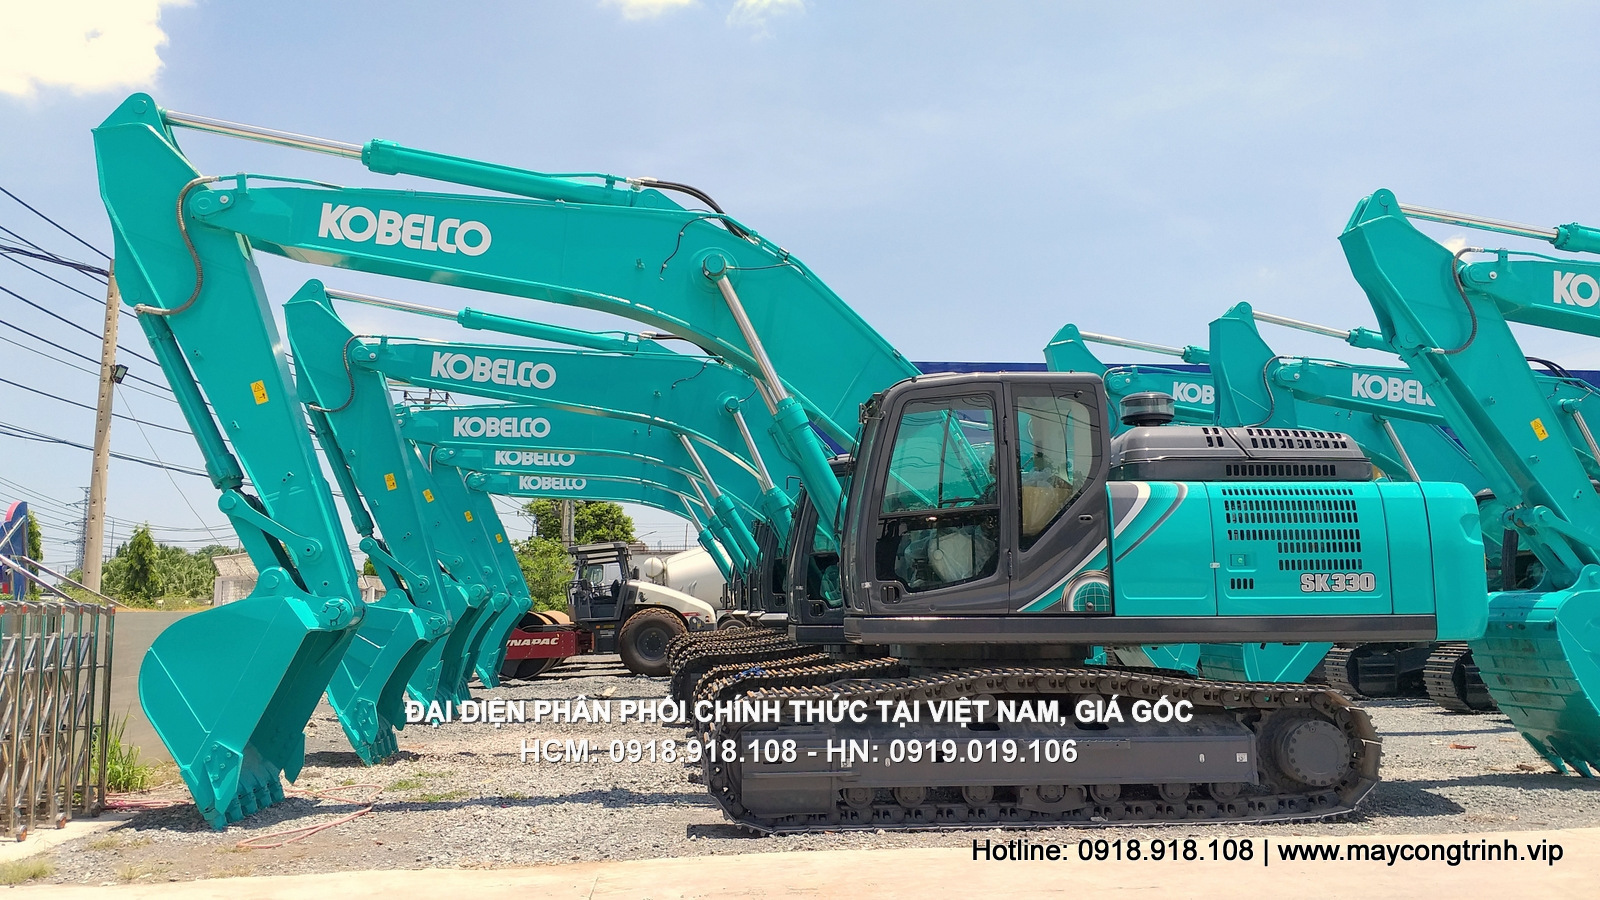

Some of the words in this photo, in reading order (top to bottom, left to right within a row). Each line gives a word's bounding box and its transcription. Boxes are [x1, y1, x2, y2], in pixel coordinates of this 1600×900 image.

[318, 202, 492, 256] KOBELCO
[1553, 270, 1600, 307] KO
[431, 351, 557, 389] KOBELCO
[453, 416, 551, 438] KOBELCO
[1300, 572, 1376, 593] SK330
